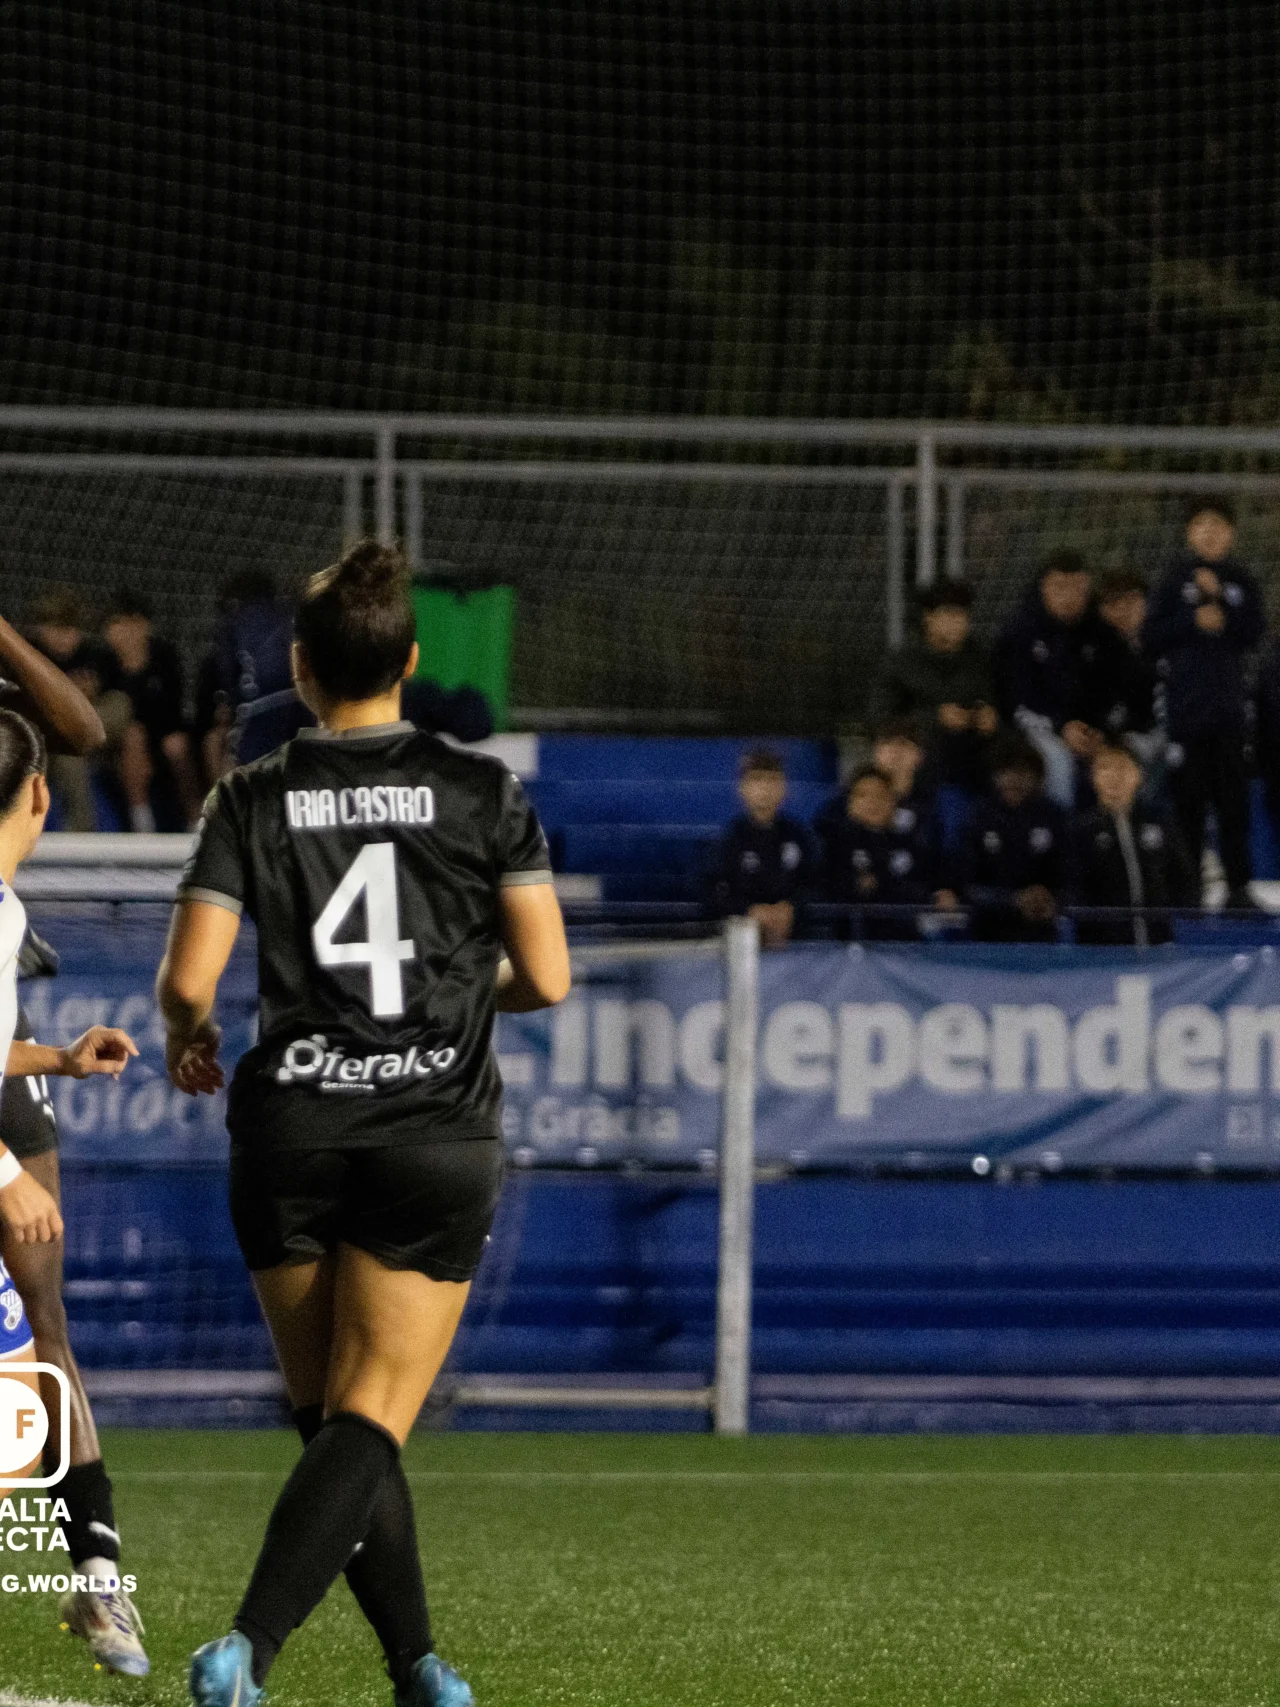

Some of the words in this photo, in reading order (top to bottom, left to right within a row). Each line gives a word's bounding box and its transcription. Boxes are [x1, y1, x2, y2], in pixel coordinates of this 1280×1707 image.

[285, 788, 336, 827] IRIA
[338, 786, 434, 825] CASTRO
[312, 842, 415, 1016] 4
